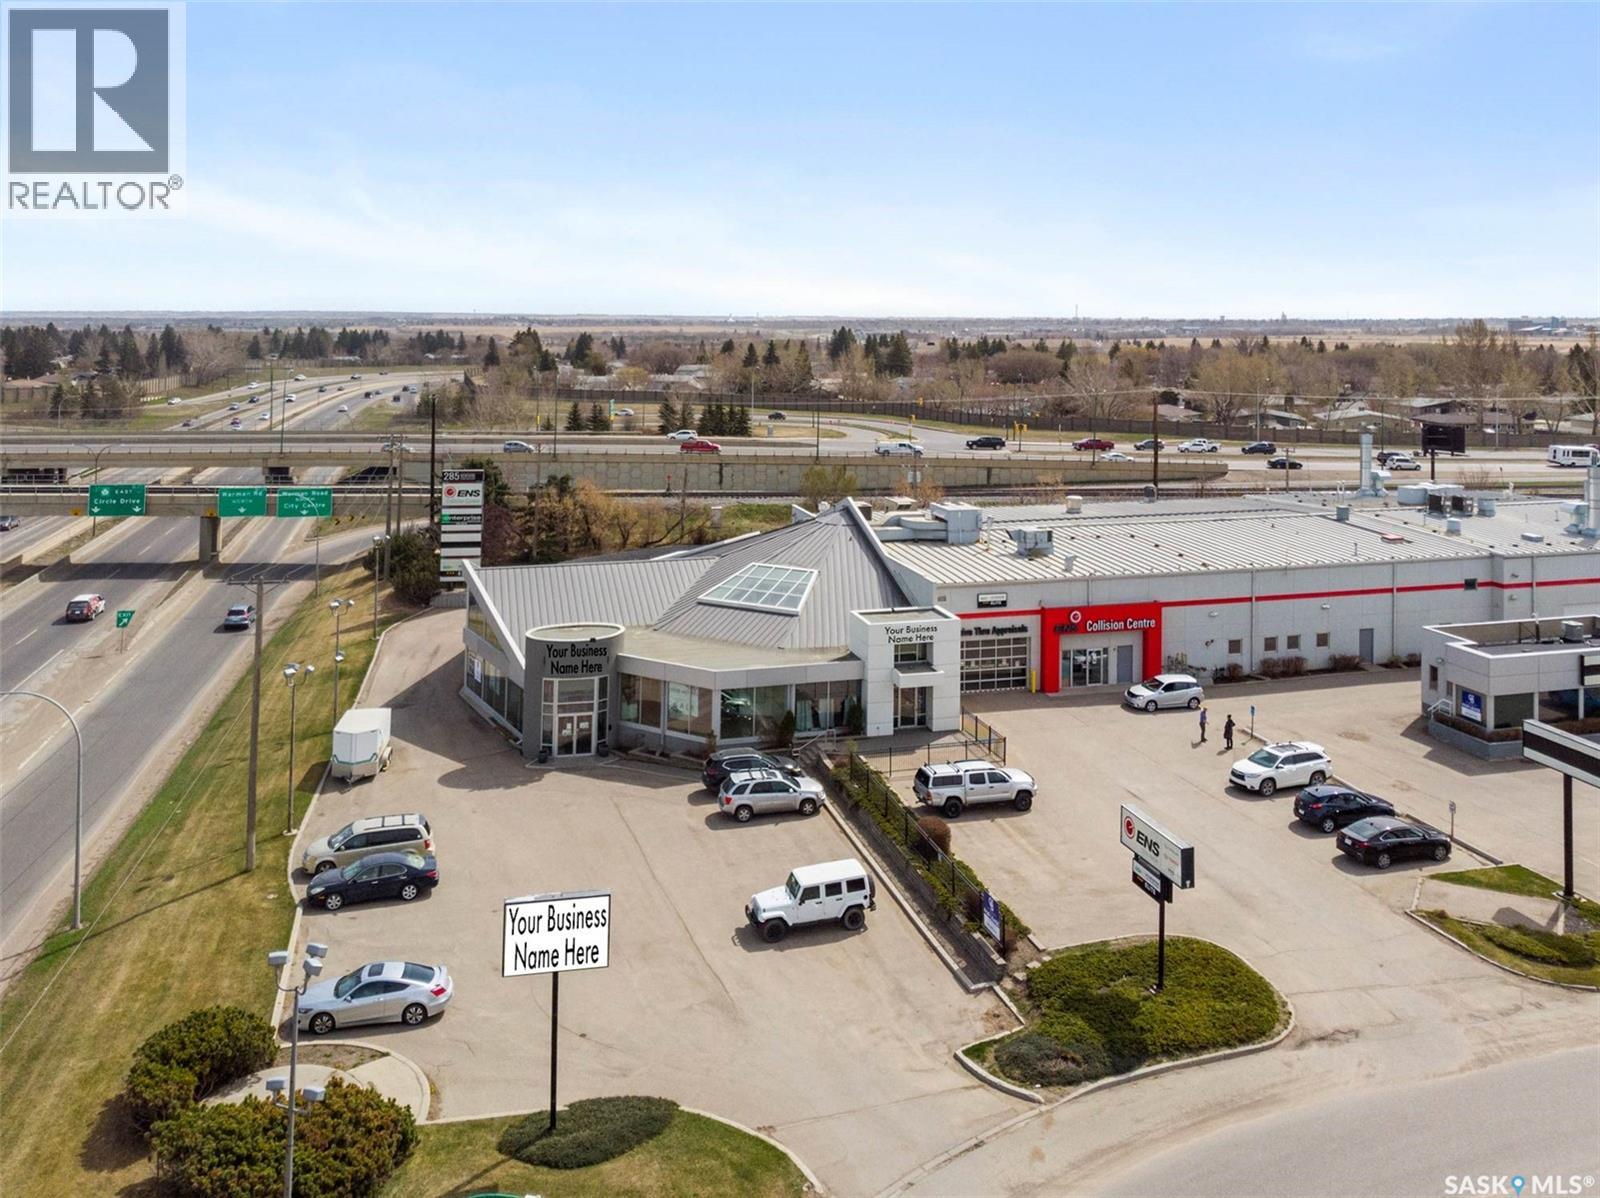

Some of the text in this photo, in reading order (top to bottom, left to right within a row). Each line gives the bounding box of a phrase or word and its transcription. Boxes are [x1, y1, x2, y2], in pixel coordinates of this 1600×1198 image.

[443, 472, 459, 480] 285
[457, 489, 481, 498] ENS
[884, 625, 938, 635] Your Business
[1086, 618, 1156, 632] Collision Centre
[888, 635, 914, 643] Name
[546, 643, 608, 659] Your Business
[550, 660, 603, 675] Name Here
[1136, 830, 1161, 857] ENS
[508, 902, 608, 936] Your Business
[514, 937, 600, 971] Name Here
